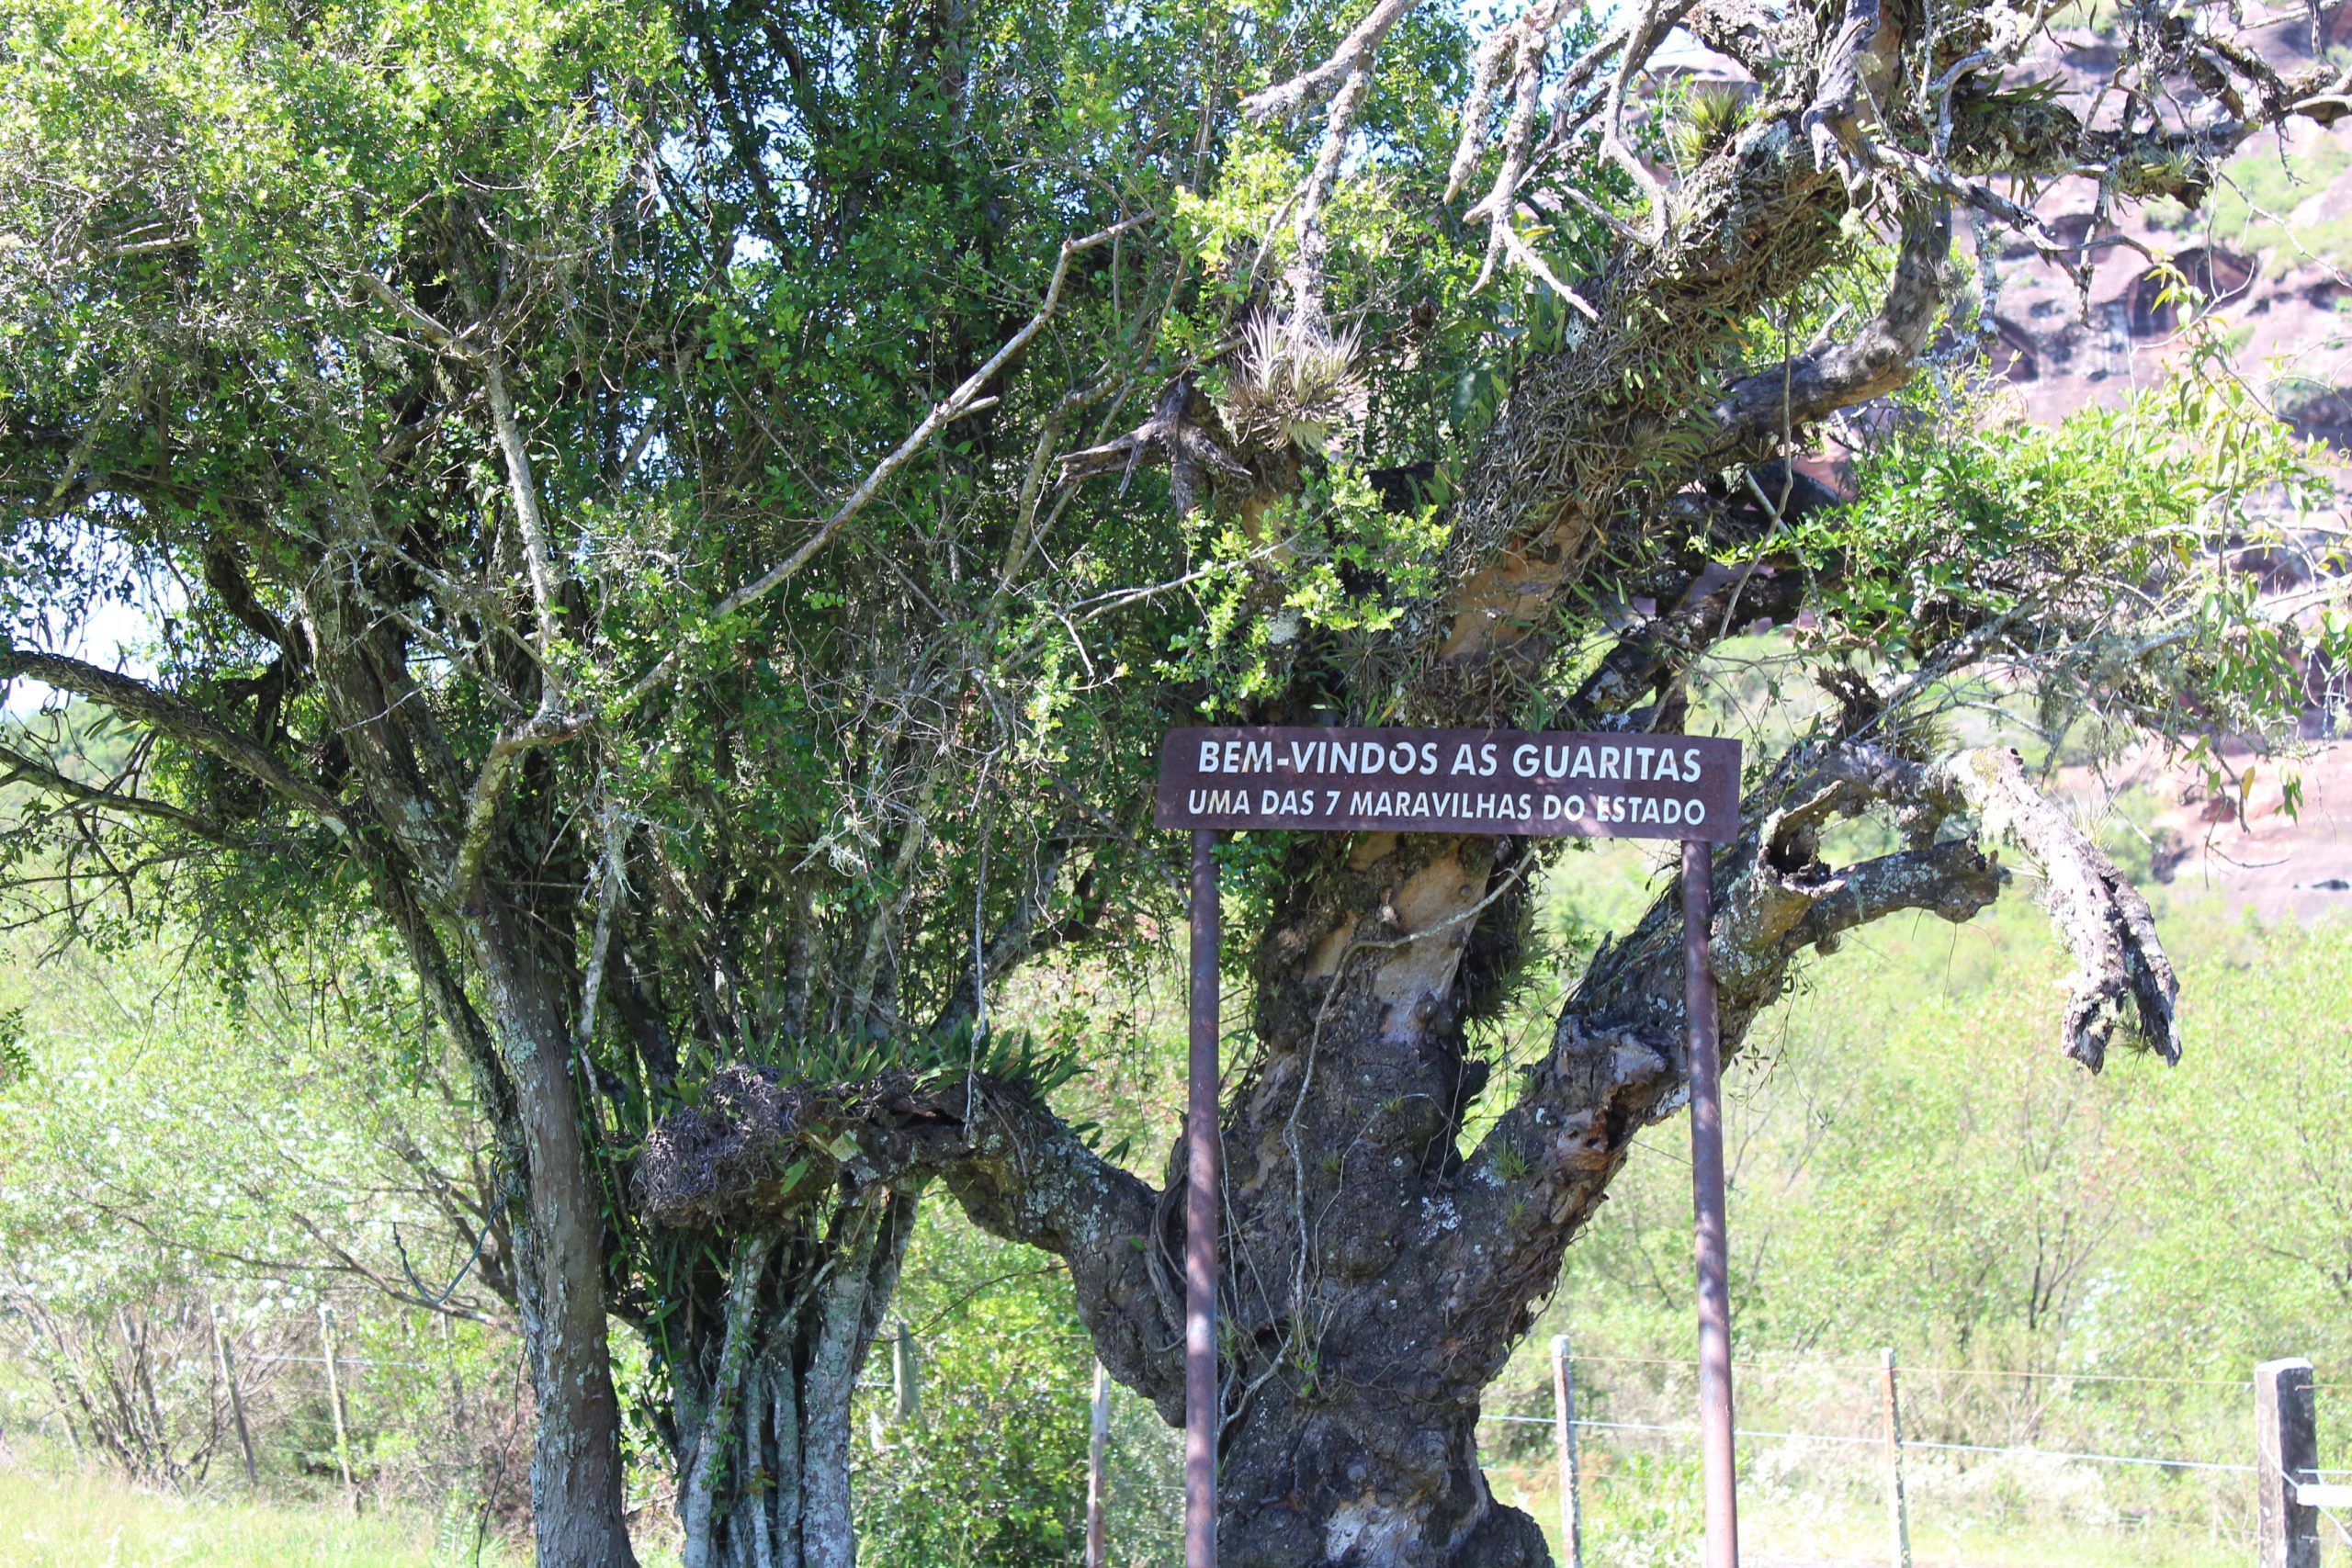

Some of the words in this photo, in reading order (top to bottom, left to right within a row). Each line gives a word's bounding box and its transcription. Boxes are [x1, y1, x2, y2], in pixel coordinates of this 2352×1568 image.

[1198, 740, 1438, 775] BEM-VINDOS
[1450, 743, 1498, 777] AS
[1512, 743, 1701, 783] GUARITAS
[1188, 789, 1250, 815] UMA
[1261, 790, 1315, 816] DAS
[1325, 791, 1340, 816] 7
[1349, 791, 1532, 820] MARAVILHAS
[1543, 795, 1585, 821] DO
[1597, 795, 1705, 825] ESTADO
